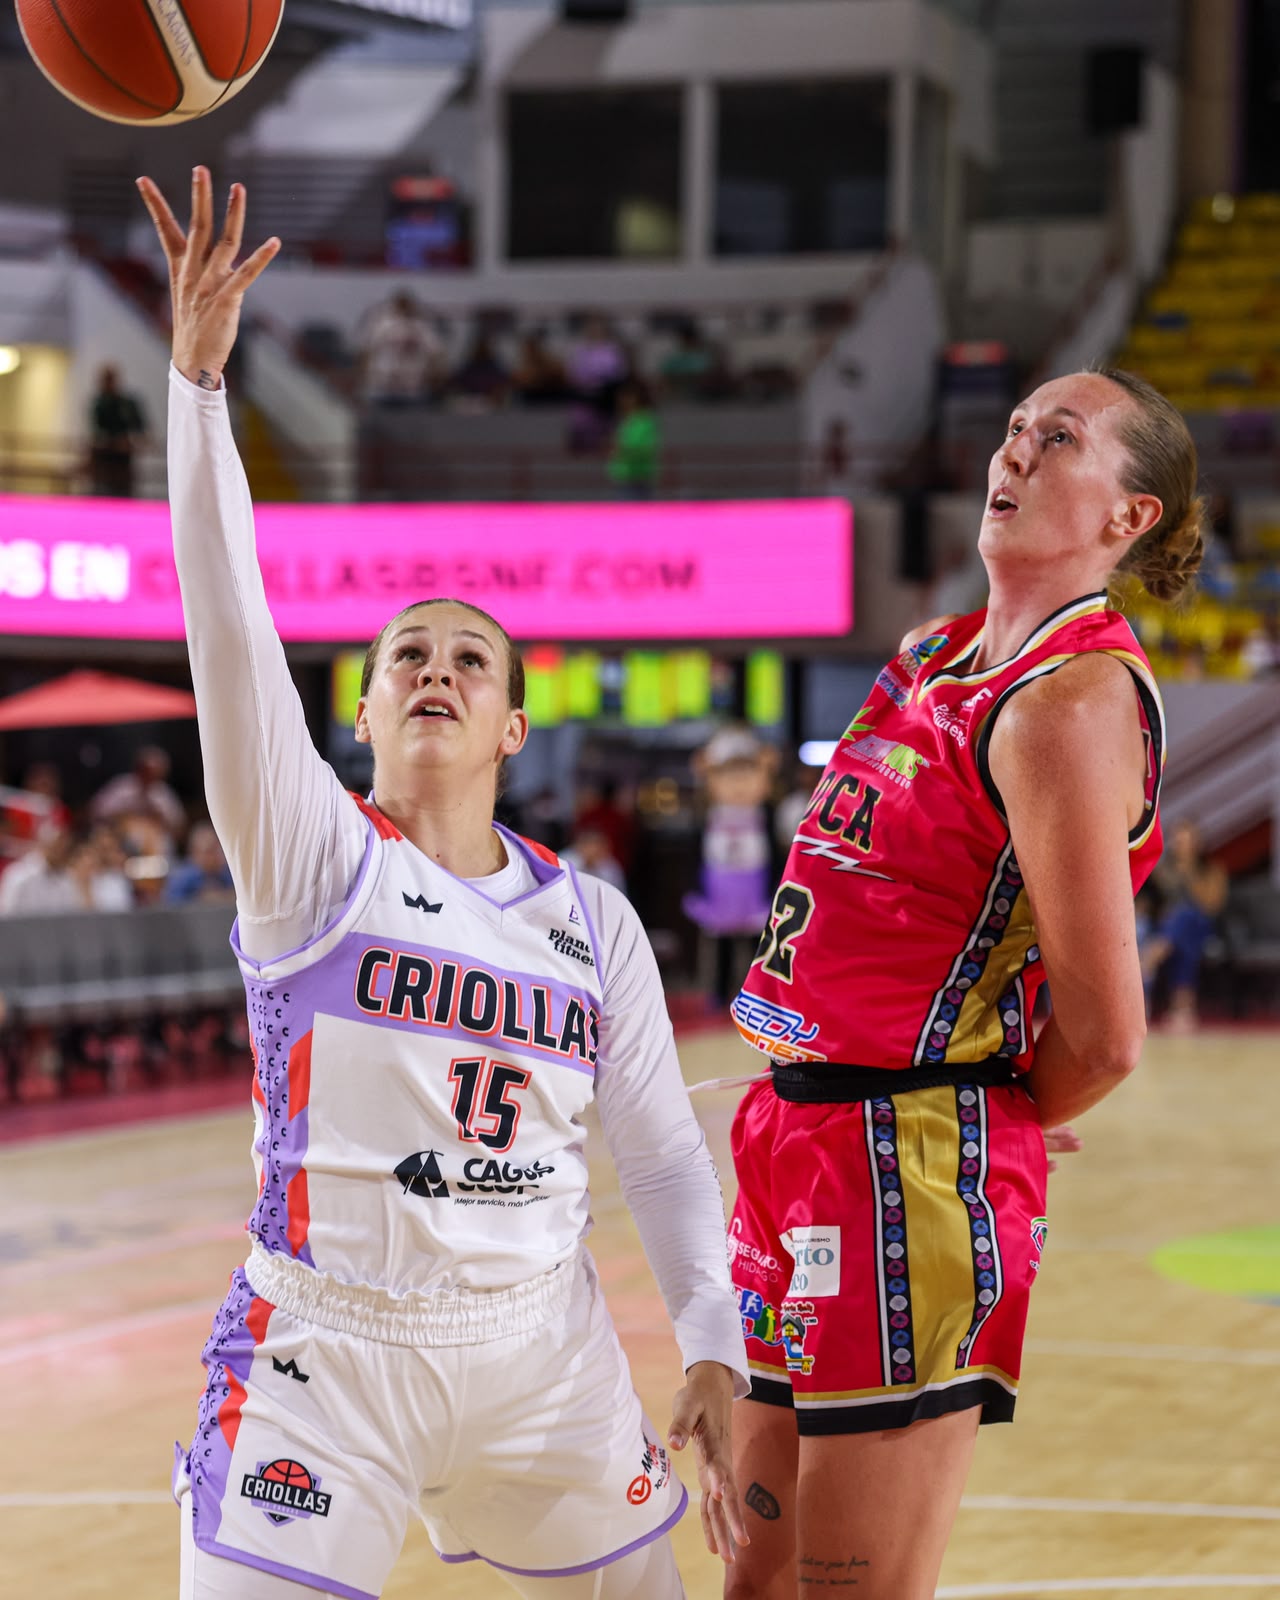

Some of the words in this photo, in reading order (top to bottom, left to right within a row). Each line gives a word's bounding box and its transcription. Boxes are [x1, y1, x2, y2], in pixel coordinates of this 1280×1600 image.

[50, 540, 131, 603] EN
[448, 1056, 533, 1154] 15
[244, 1477, 328, 1514] CRIOLLAS
